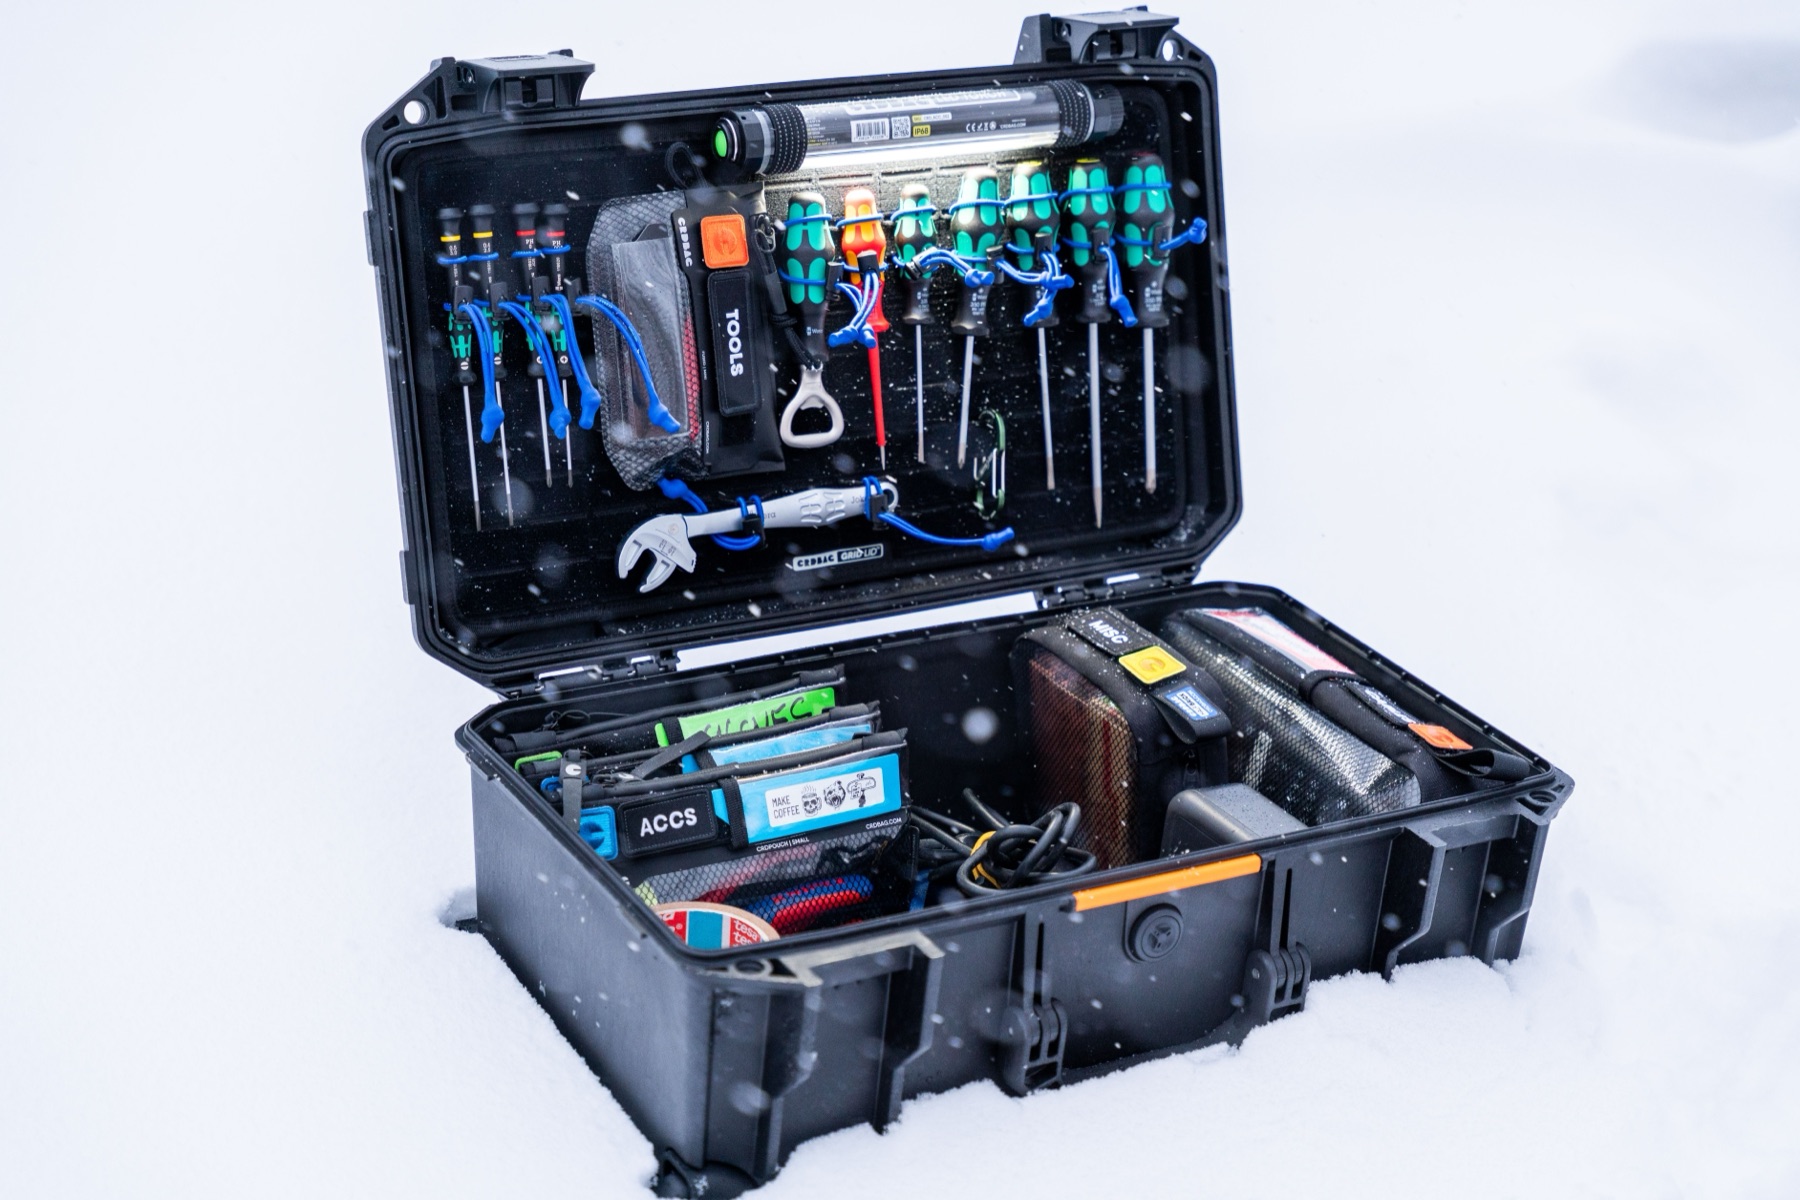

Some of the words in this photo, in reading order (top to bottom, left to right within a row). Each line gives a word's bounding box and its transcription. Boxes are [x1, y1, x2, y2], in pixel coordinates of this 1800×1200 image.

[914, 126, 929, 136] IP68
[677, 217, 693, 267] CRDBAG
[725, 308, 744, 377] TOOLS
[797, 554, 835, 567] CRDBAG
[1088, 619, 1129, 644] MISC
[771, 795, 791, 807] MAKE
[773, 805, 801, 819] COFFEE
[640, 807, 698, 838] ACCS
[865, 817, 902, 830] CRDBAG.COM
[756, 840, 789, 852] CRDPOUCH
[792, 837, 810, 846] SMALL
[733, 919, 758, 942] tesa
